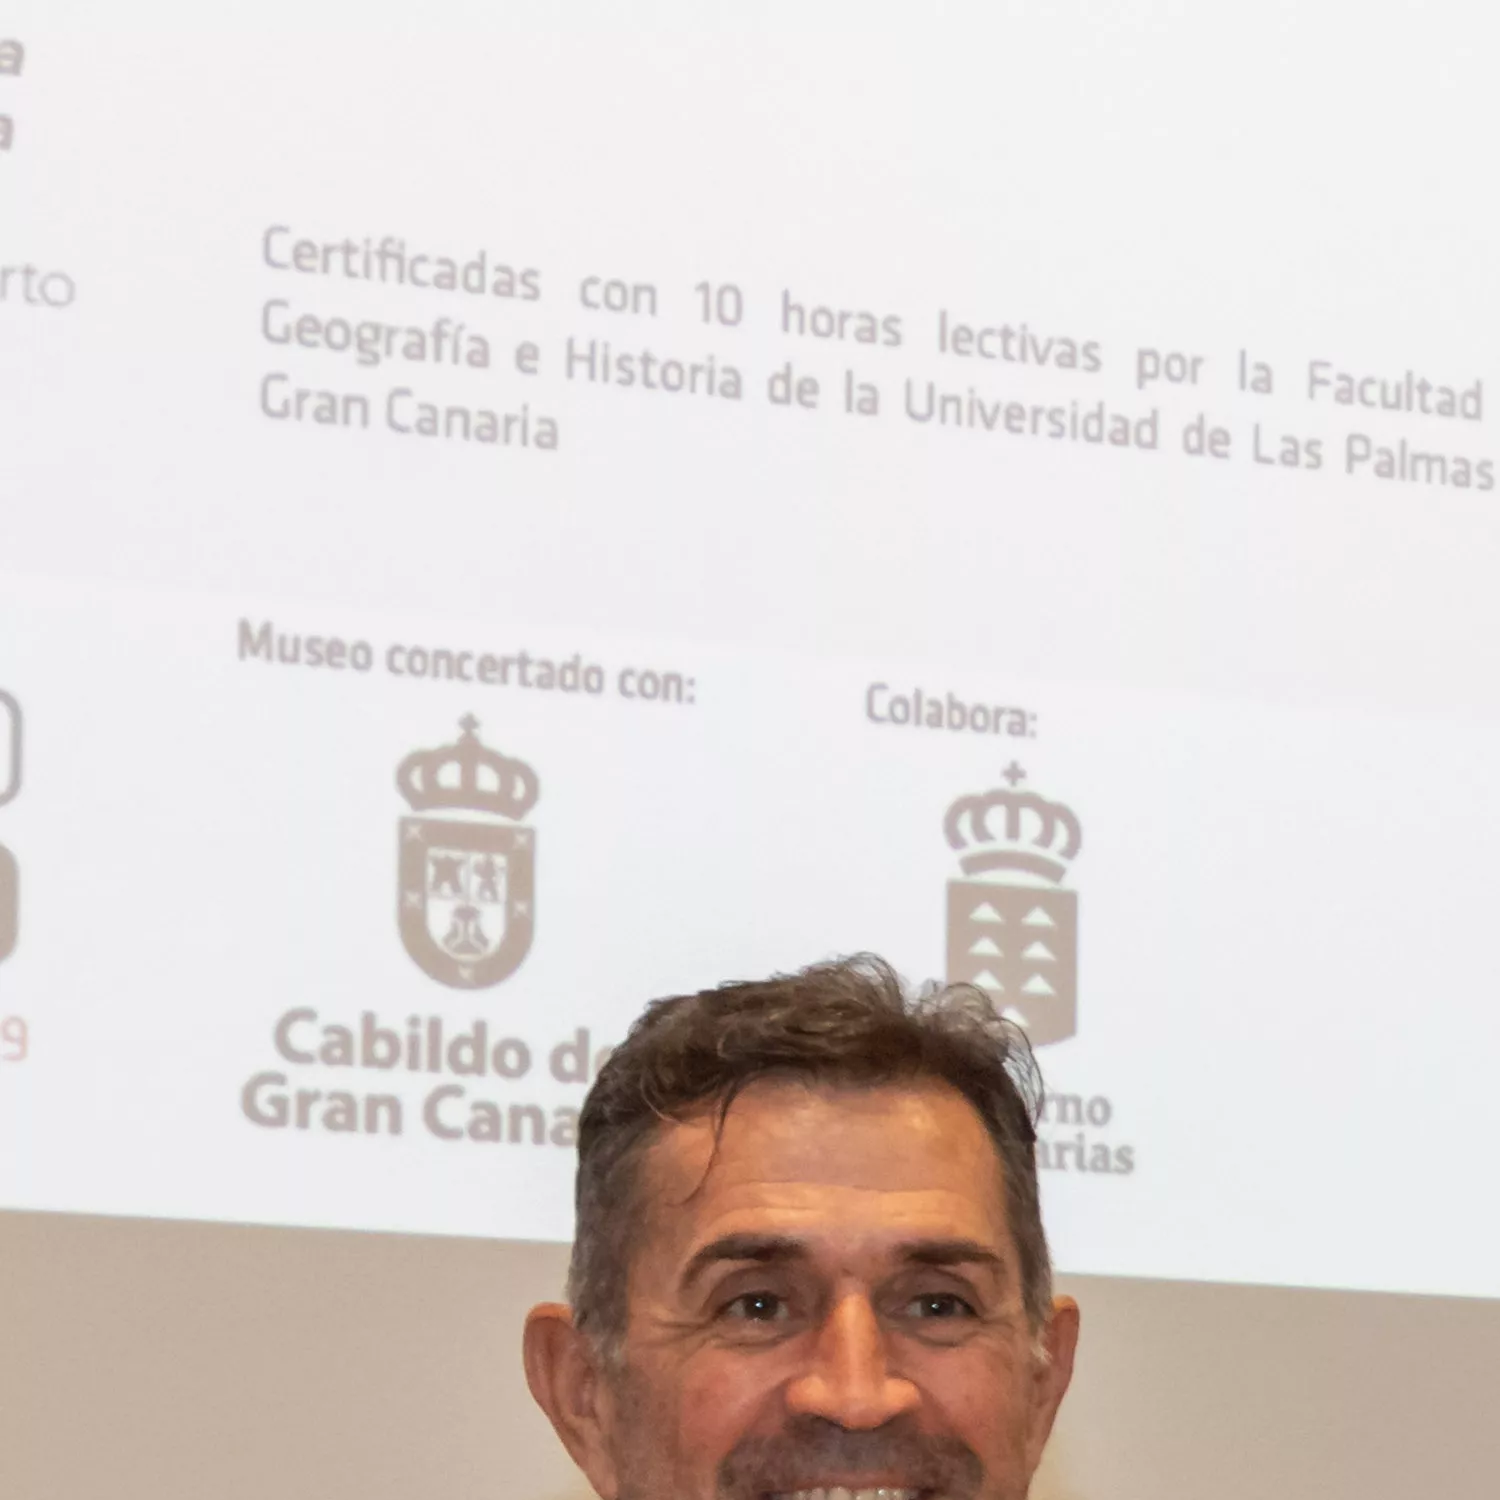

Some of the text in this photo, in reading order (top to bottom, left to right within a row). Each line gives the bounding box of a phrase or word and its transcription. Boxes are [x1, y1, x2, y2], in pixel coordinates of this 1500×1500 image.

[261, 224, 542, 303] Certificadas
[579, 275, 658, 317] con
[693, 280, 744, 328] 10
[781, 288, 903, 348] horas
[937, 309, 1103, 373] lectivas
[1136, 347, 1205, 390] por
[1237, 348, 1274, 395] la
[1307, 359, 1484, 422] Facultad
[259, 372, 560, 451] Gran Canaria
[260, 299, 491, 368] Geografía
[514, 340, 540, 375] e
[565, 336, 743, 402] Historia
[767, 361, 821, 410] de
[844, 368, 880, 417] la
[903, 378, 1160, 451] Universidad
[1182, 412, 1232, 460] de
[1252, 422, 1324, 471] Las
[1344, 433, 1496, 492] Palmas
[237, 617, 697, 705] Museo concertado con:
[865, 682, 1039, 739] Colabora:
[272, 1006, 533, 1082] Cabildo
[240, 1071, 578, 1149] Gran Cana
